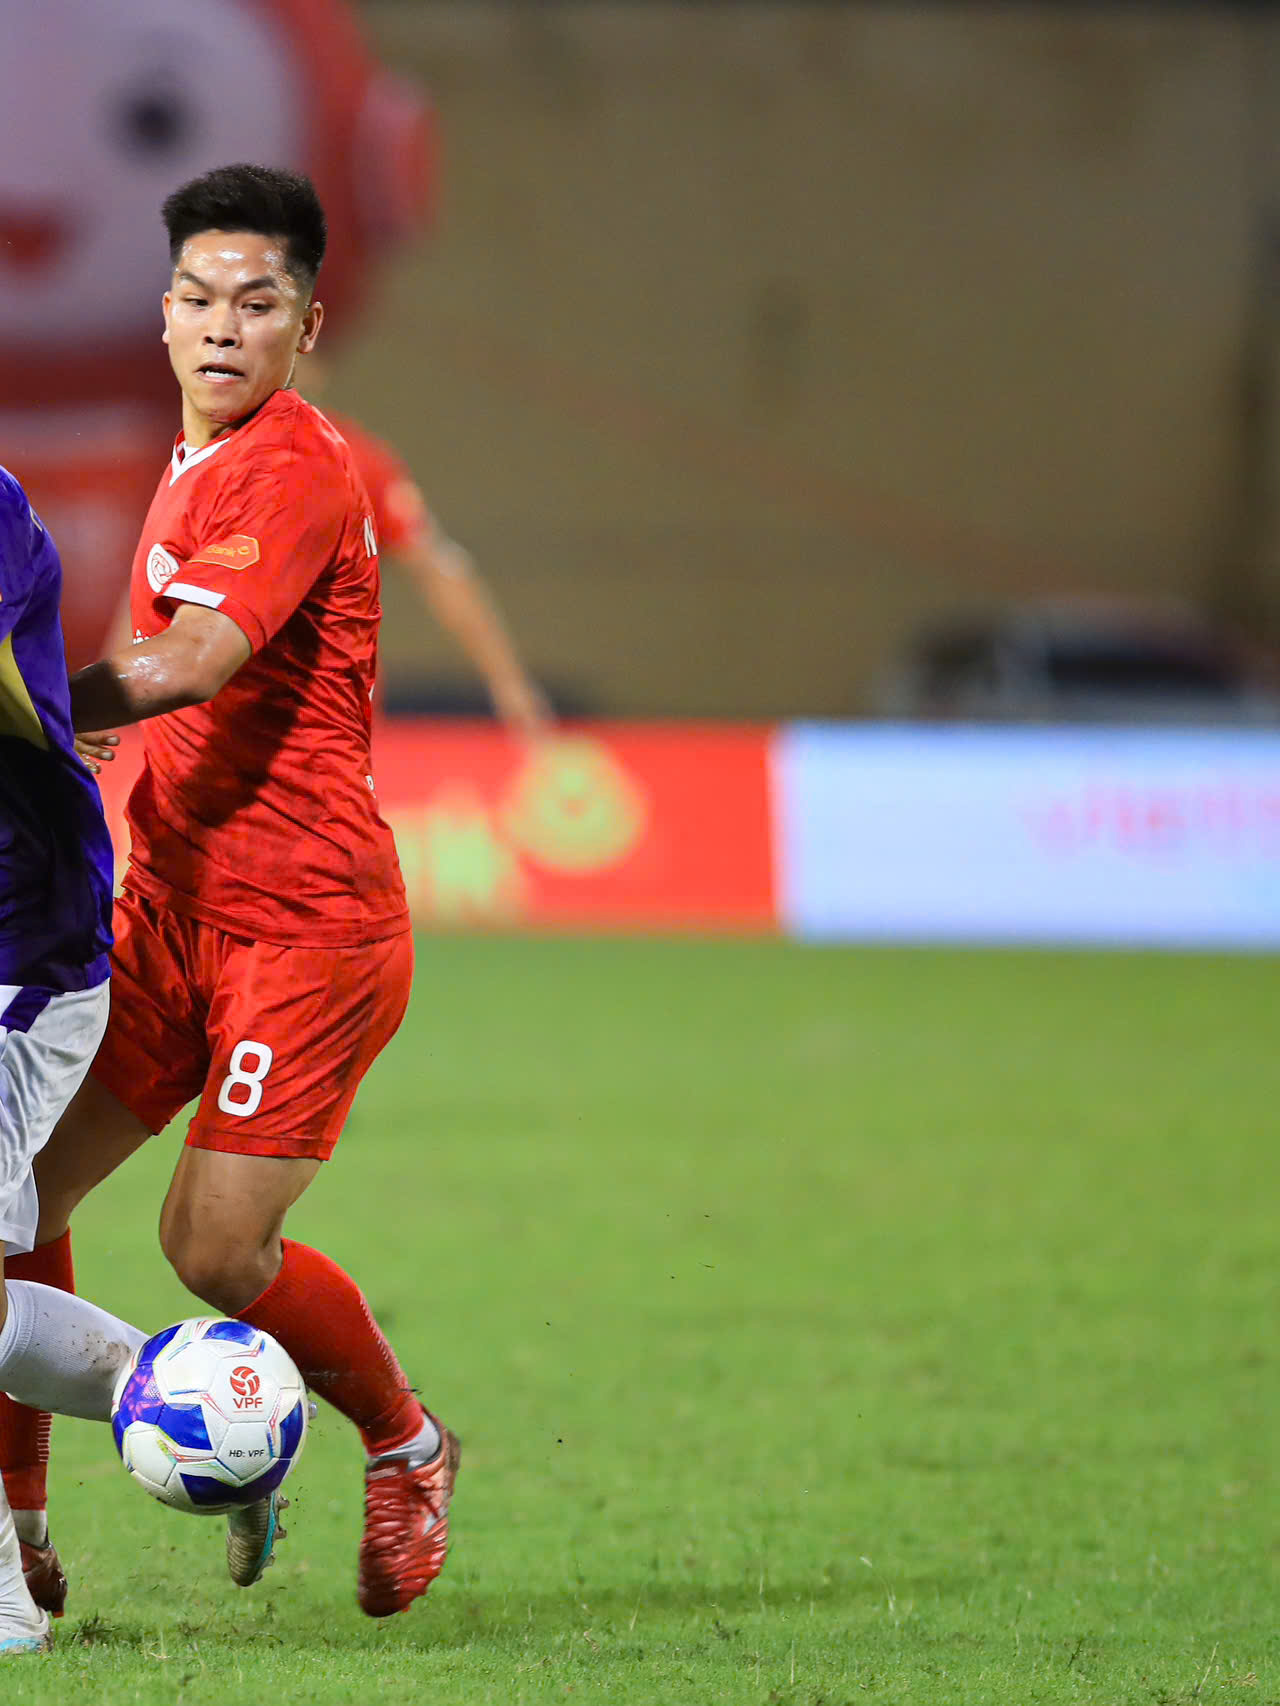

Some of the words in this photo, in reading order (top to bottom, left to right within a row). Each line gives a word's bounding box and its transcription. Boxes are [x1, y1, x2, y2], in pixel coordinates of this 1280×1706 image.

[217, 1039, 274, 1117] 8
[232, 1397, 263, 1409] VPF
[248, 1449, 265, 1457] VPF
